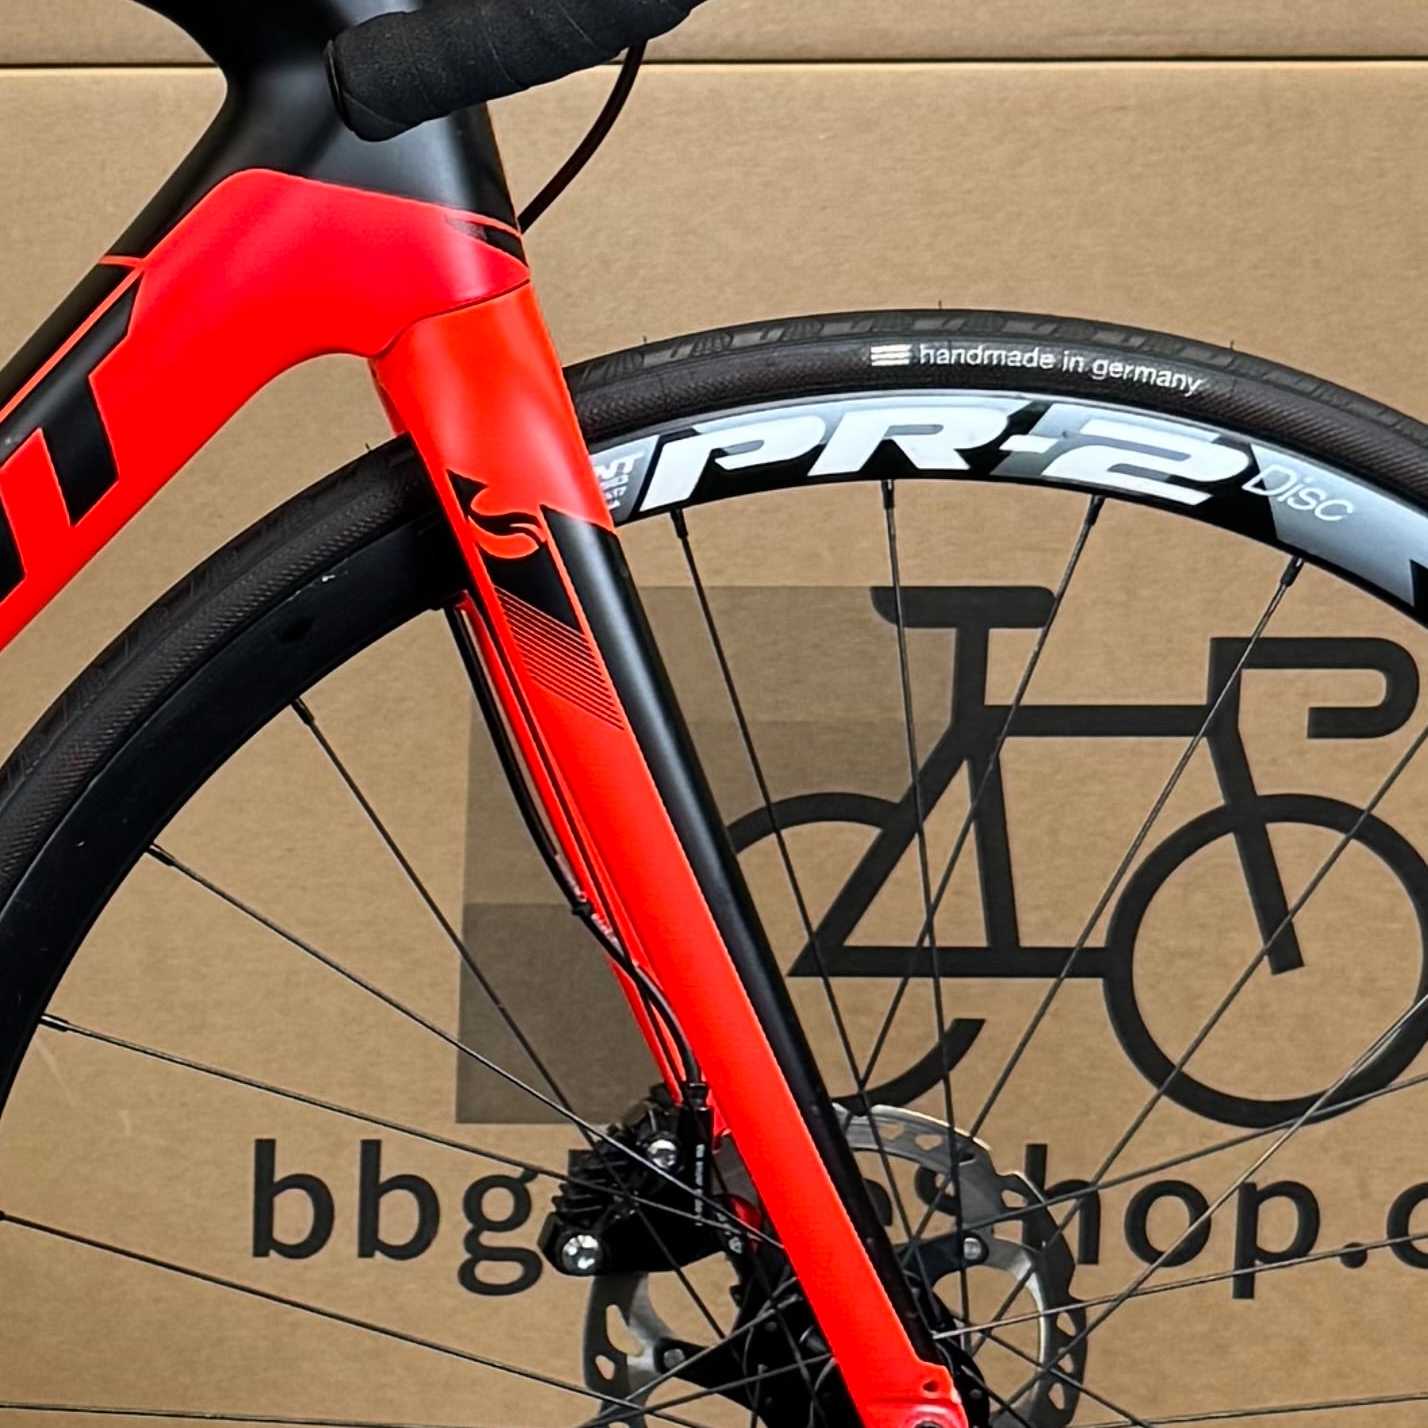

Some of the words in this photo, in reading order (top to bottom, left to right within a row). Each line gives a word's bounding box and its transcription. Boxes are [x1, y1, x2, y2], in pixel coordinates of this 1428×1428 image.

[920, 344, 1056, 370] handmade
[1062, 350, 1085, 371] in
[1092, 358, 1204, 396] germany
[639, 402, 1251, 512] PR-2
[1241, 462, 1355, 524] Disc
